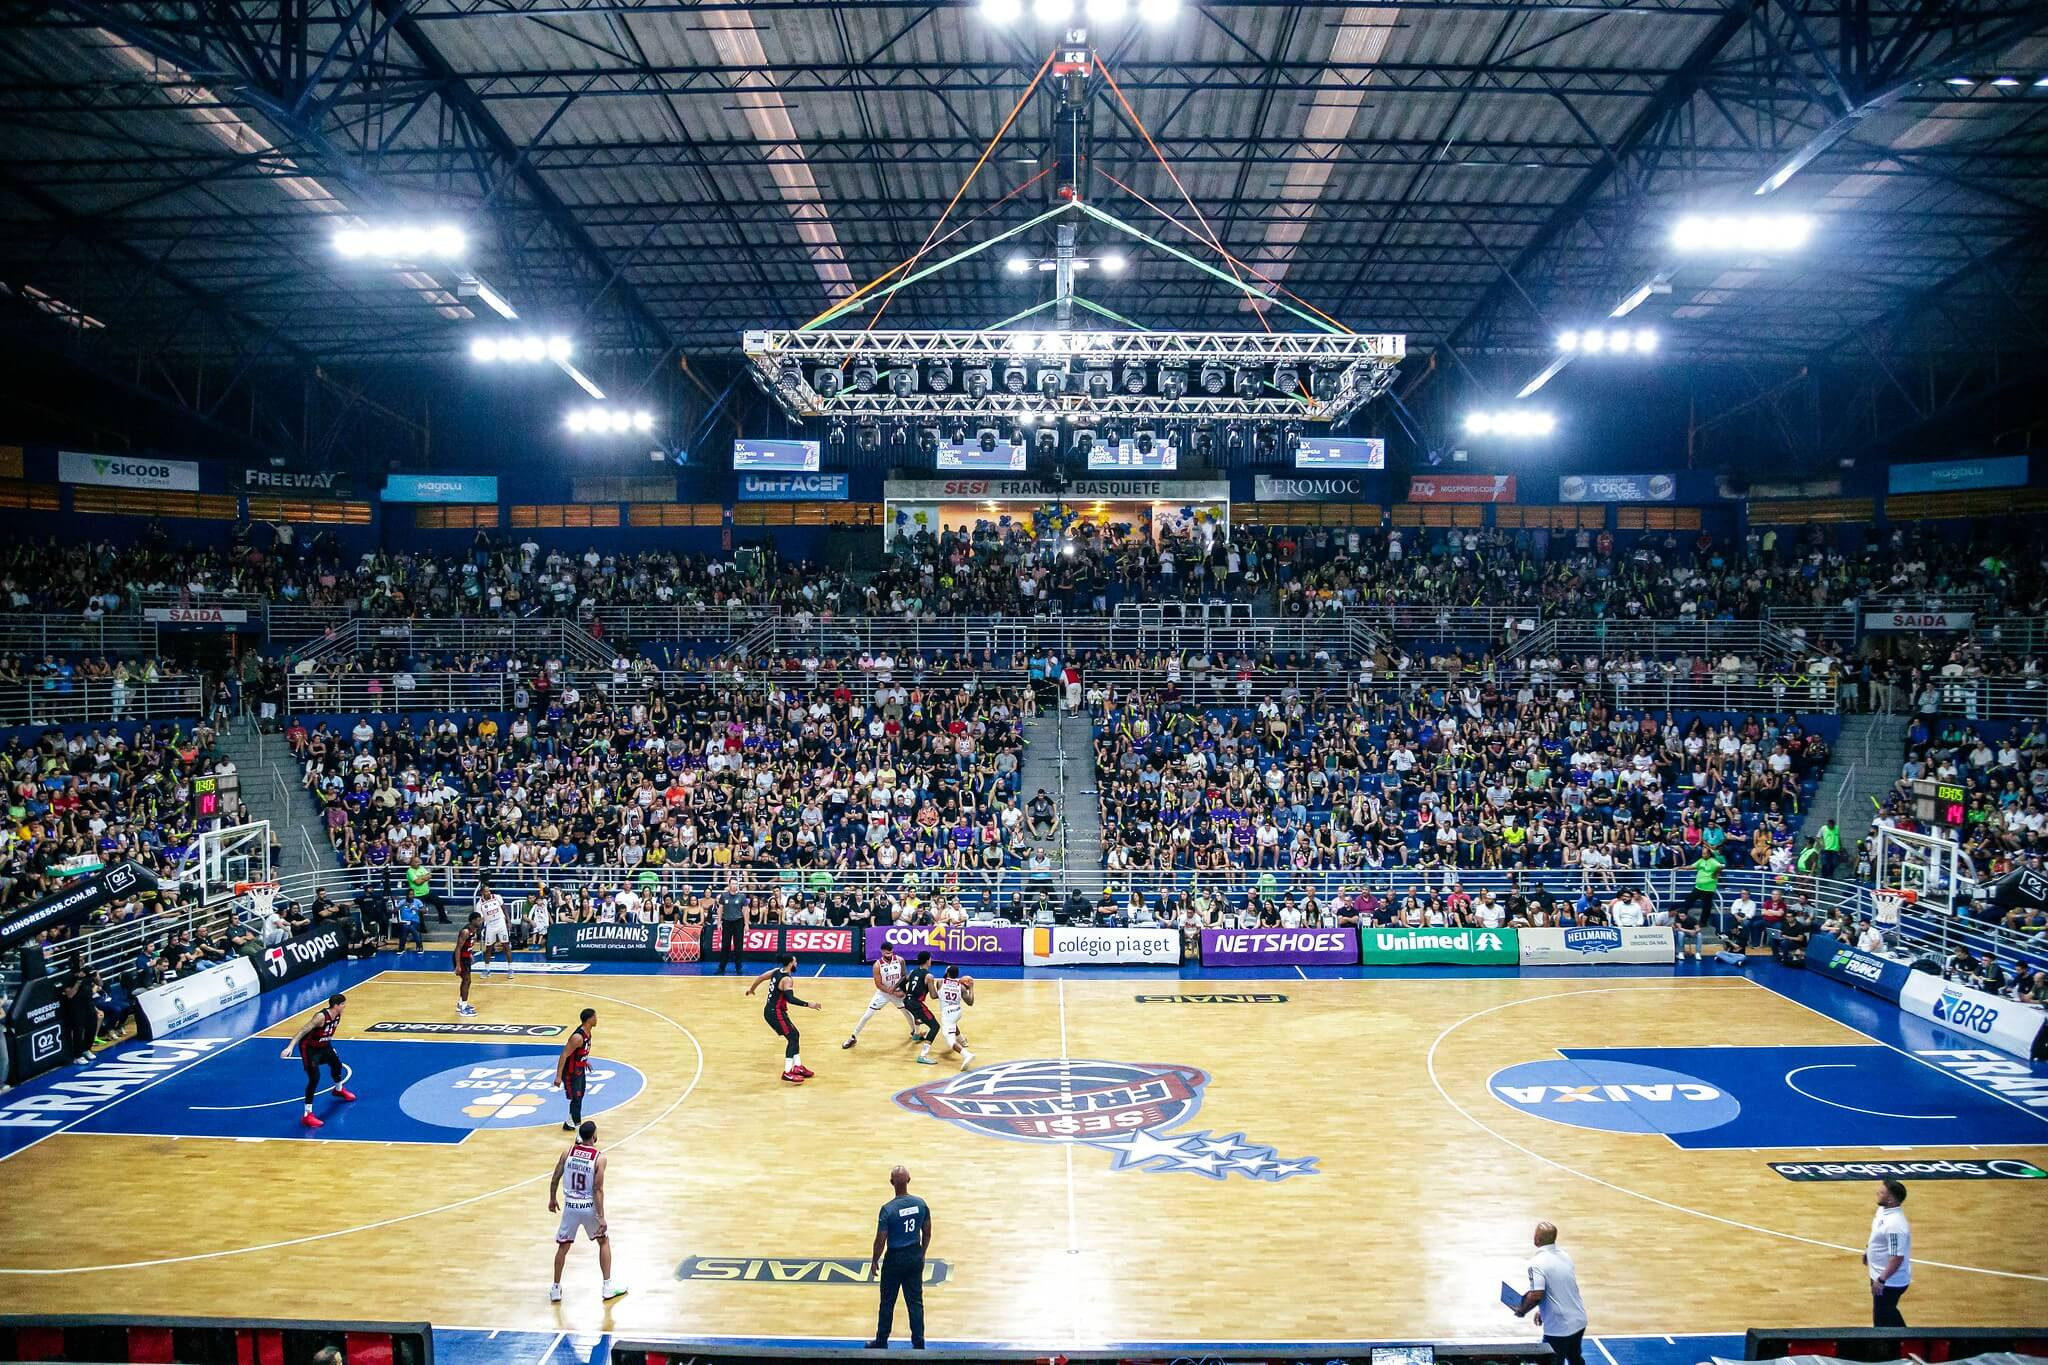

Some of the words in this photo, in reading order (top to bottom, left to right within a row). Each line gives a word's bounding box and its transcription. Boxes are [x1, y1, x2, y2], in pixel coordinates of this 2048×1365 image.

[111, 463, 170, 478] SICOOB
[246, 469, 335, 488] FREEWAY
[944, 481, 989, 495] SESI
[1075, 482, 1161, 496] BASQUETE
[1260, 479, 1360, 496] VEROMOC
[1591, 482, 1636, 493] TORCE
[203, 794, 215, 813] 14
[1948, 805, 1963, 823] 14
[112, 872, 126, 883] Q2
[1, 886, 98, 936] Q2INGRESSOS.COM.BR
[576, 925, 649, 942] HELLMANN'S
[791, 932, 846, 950] SESI
[1376, 932, 1469, 951] Unimed
[1567, 929, 1618, 942] HELLMANN'S
[286, 931, 339, 962] Topper
[1058, 936, 1111, 956] colégio
[1116, 936, 1170, 956] piaget
[1215, 933, 1345, 953] NETSHOES
[1845, 960, 1882, 980] FRANCA
[1144, 994, 1282, 1004] FINAIS
[1943, 986, 1963, 998] banco
[27, 1001, 60, 1019] INGRESSOS
[34, 1010, 56, 1024] ONLINE
[1952, 1000, 1998, 1034] BRB
[375, 1022, 525, 1034] Sportsbet.io
[38, 1034, 54, 1048] Q2
[0, 1037, 233, 1127] FRANCA
[469, 1067, 616, 1081] CIXA
[961, 1078, 1172, 1116] FRANCA
[1495, 1083, 1721, 1104] CAIXA
[1035, 1110, 1145, 1135] SESI
[1775, 1160, 1988, 1176] Sportsbet.io
[571, 1172, 586, 1191] 19
[904, 1218, 916, 1233] 13
